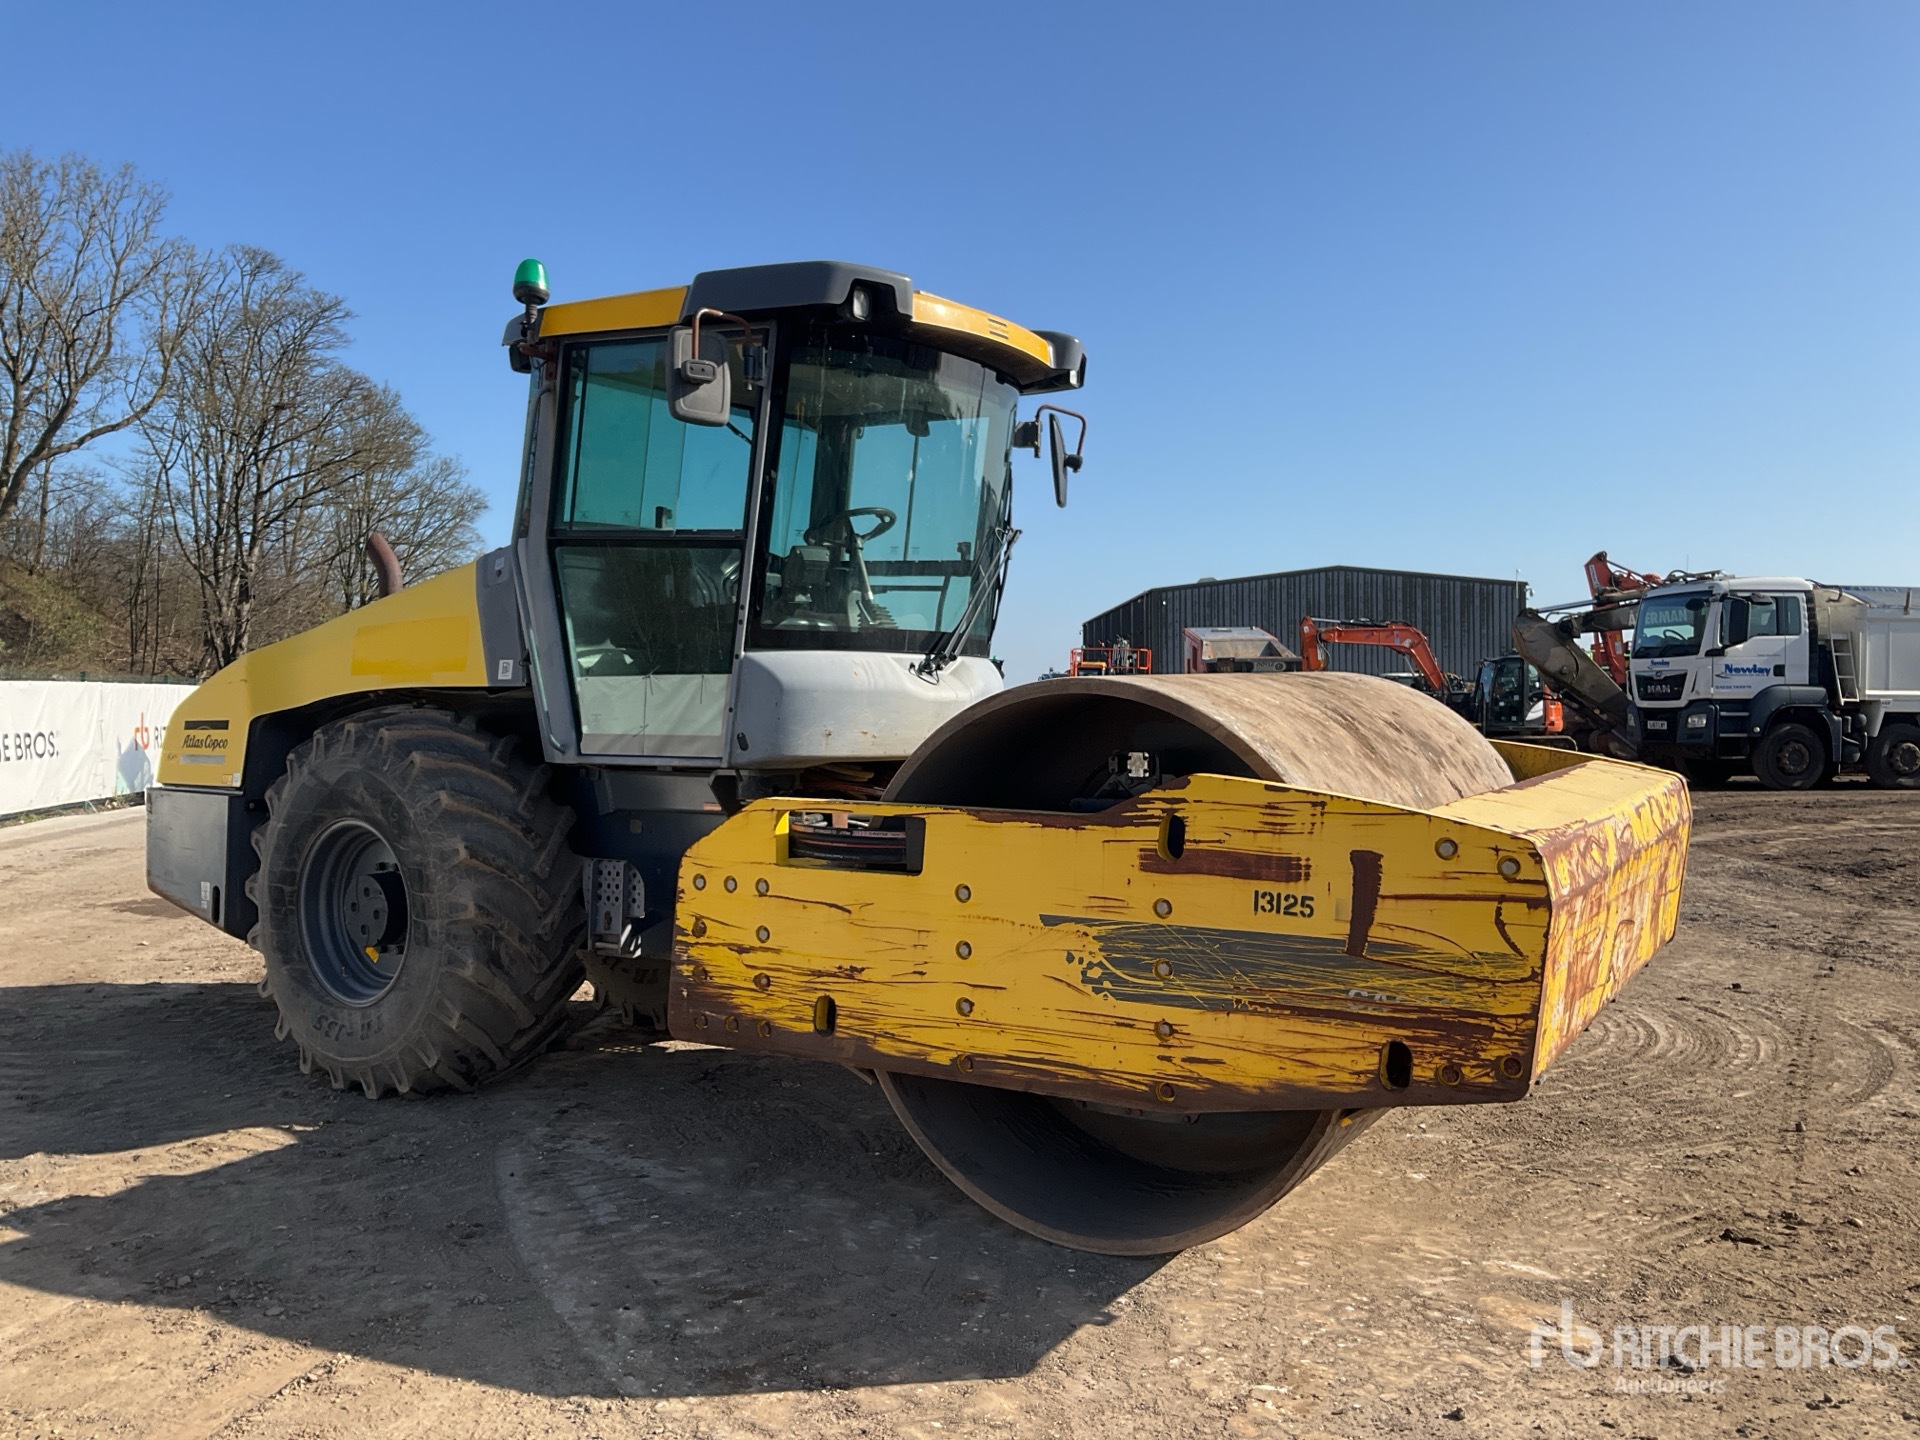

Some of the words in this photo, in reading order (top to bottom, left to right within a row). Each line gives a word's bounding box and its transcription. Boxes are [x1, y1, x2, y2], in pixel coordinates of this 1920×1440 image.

[1628, 609, 1688, 627] ÅERMAN
[1647, 684, 1671, 694] MAN
[14, 731, 59, 761] BROS.
[182, 734, 204, 749] Atlas
[204, 734, 229, 751] Copco
[1253, 889, 1315, 919] 13125
